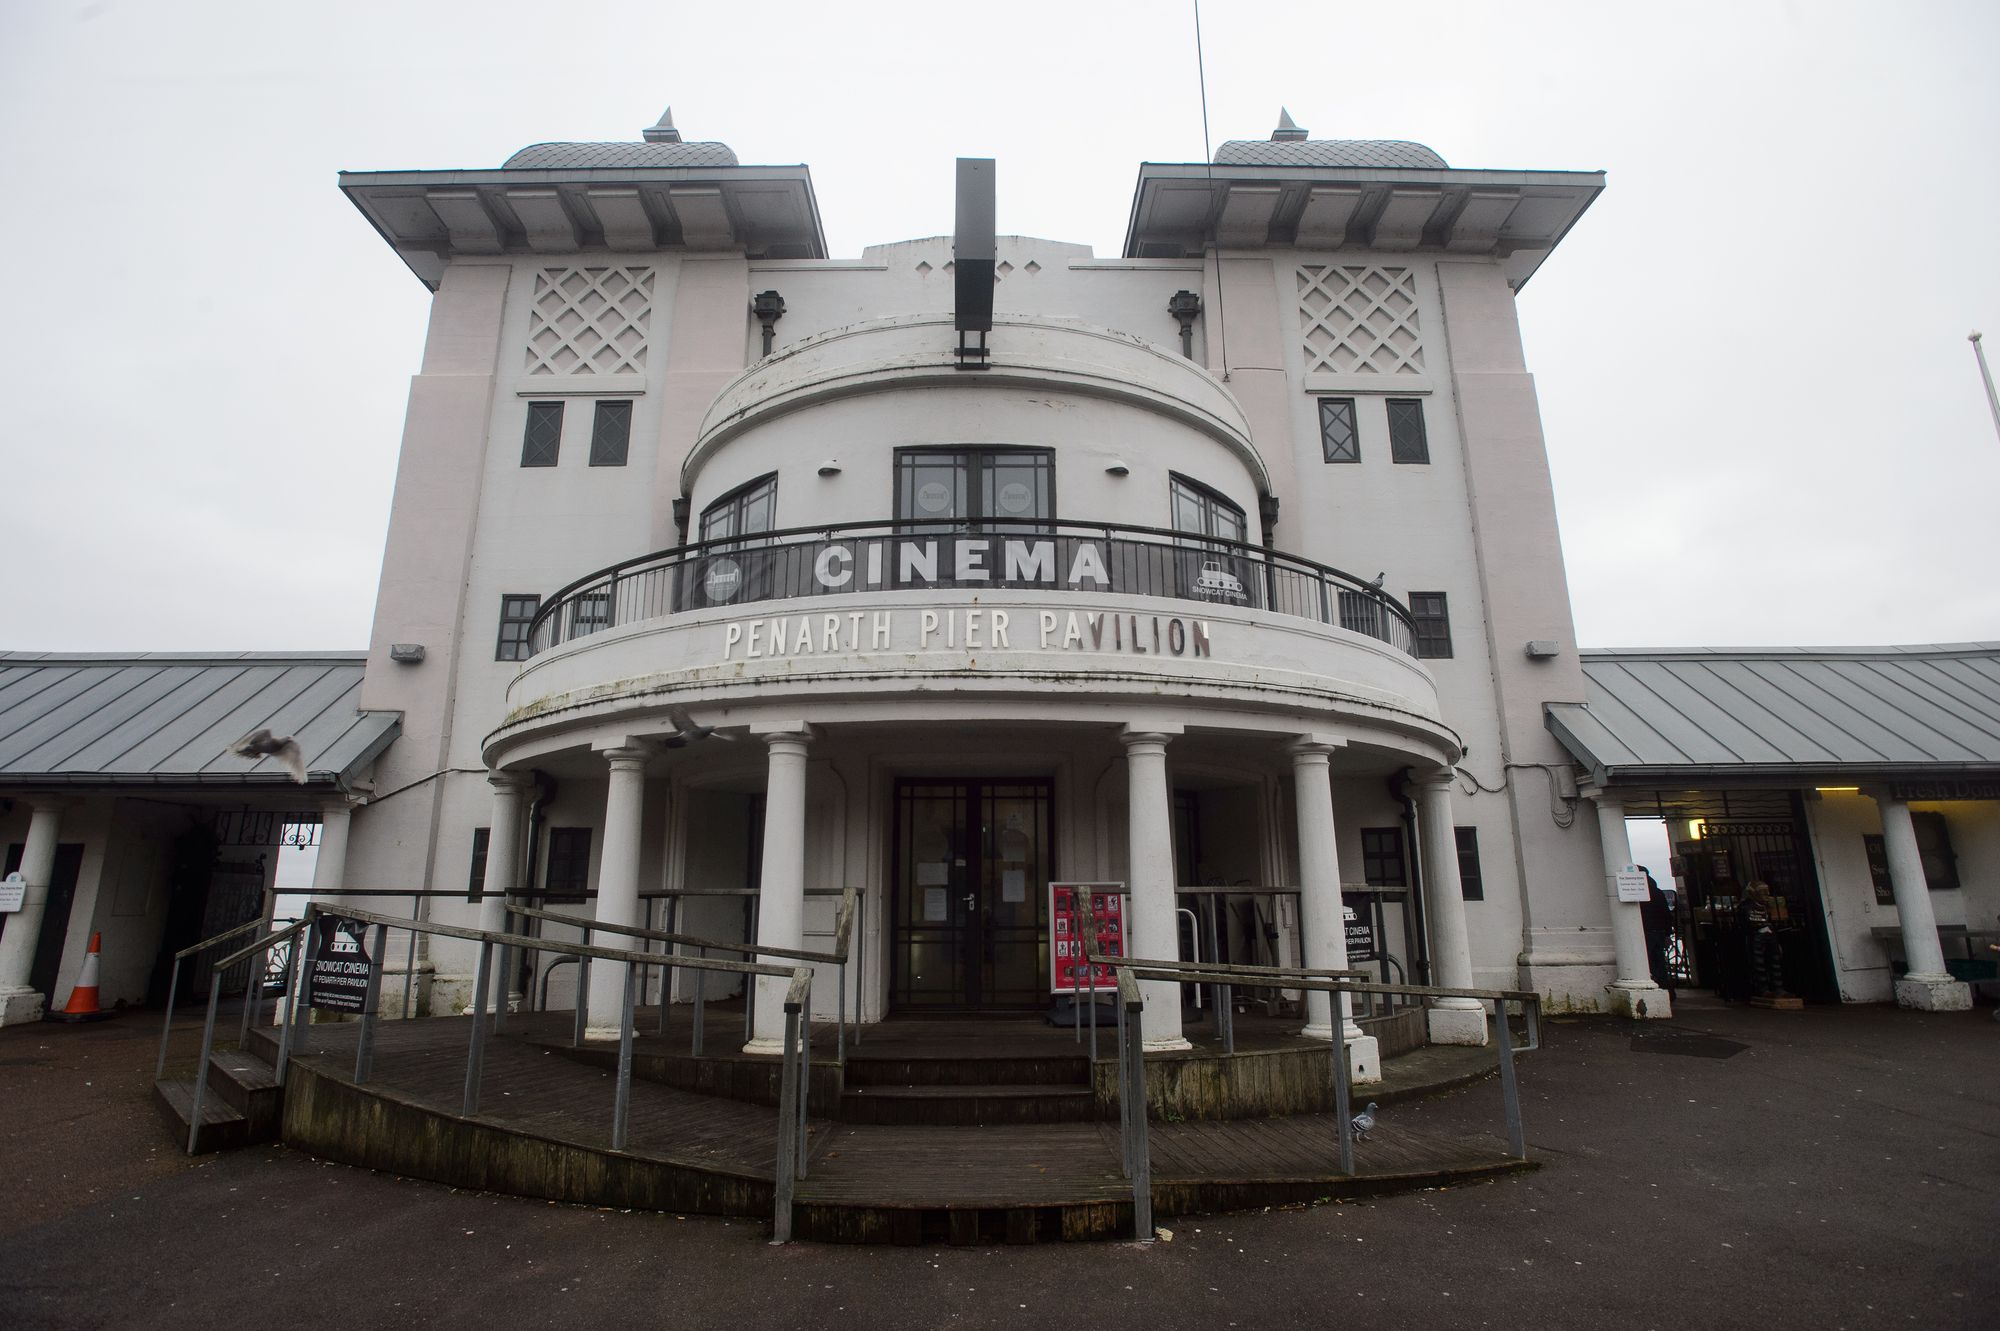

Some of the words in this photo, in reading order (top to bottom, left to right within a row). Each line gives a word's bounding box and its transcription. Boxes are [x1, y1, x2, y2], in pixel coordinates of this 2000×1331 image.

[815, 540, 1110, 587] CINEMA
[1192, 586, 1224, 595] SNOWCAT
[1225, 590, 1248, 600] CINEMA
[724, 611, 891, 660] PENARTH
[920, 609, 1010, 649] PIER
[1040, 610, 1211, 657] PAVILION
[1349, 926, 1370, 936] CINEMA
[316, 960, 344, 972] SNOWCAT
[344, 962, 368, 974] CINEMA
